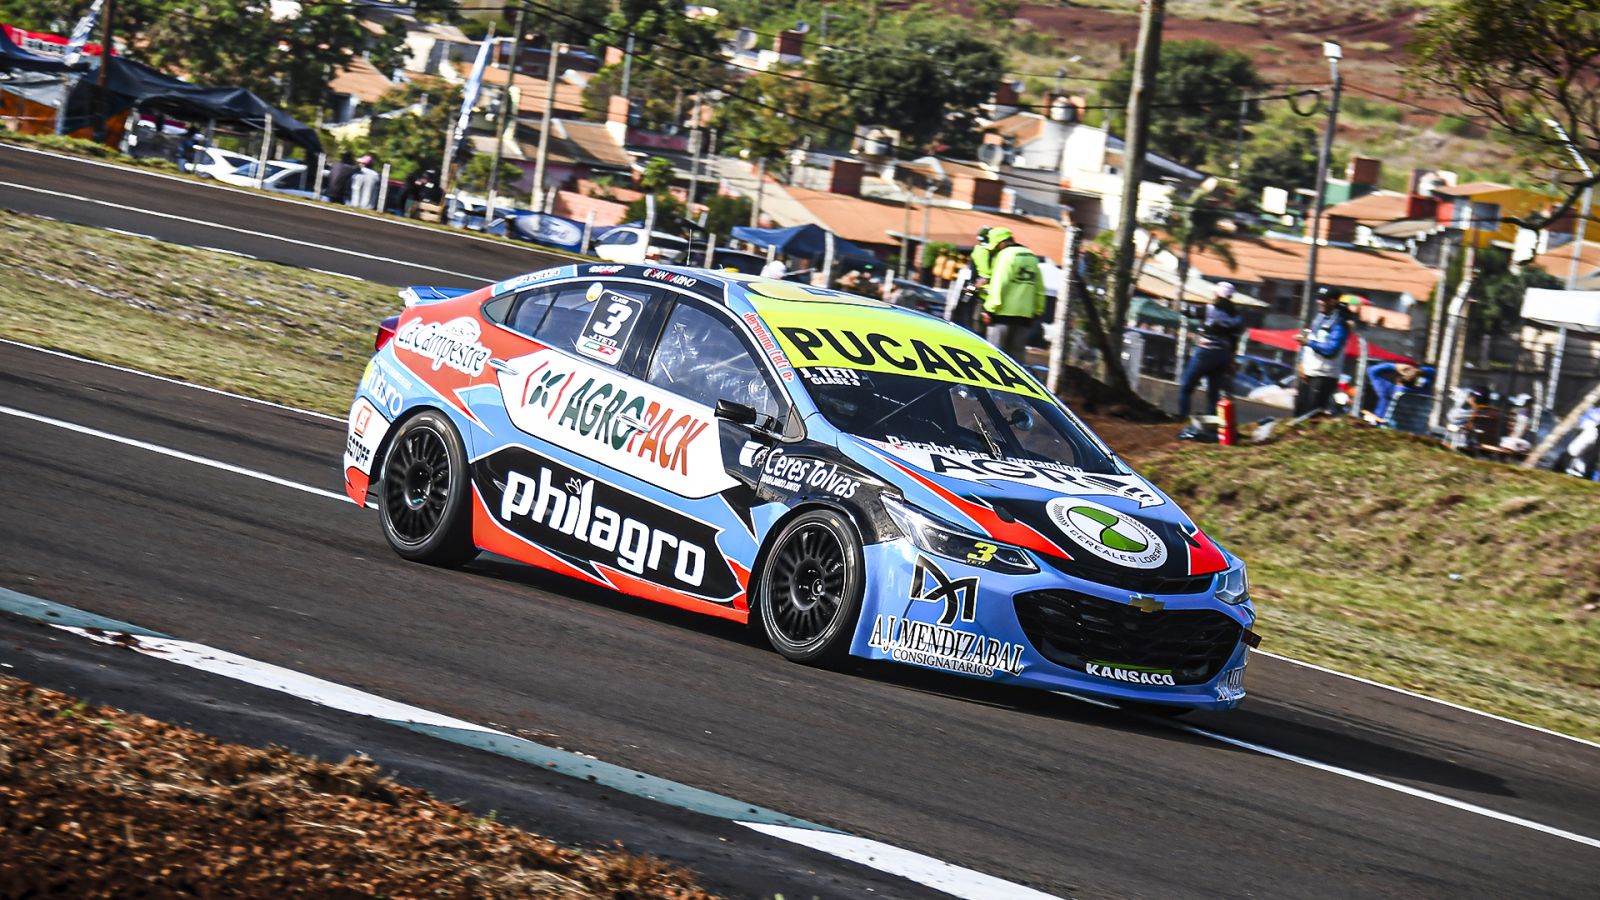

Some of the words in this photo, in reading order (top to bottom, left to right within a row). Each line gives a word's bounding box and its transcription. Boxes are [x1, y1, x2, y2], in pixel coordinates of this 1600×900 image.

[592, 303, 633, 337] 3
[414, 325, 487, 372] Campestre
[778, 327, 1041, 395] PUCARA
[558, 377, 709, 477] AGROPACK
[765, 448, 810, 482] Ceres
[806, 459, 861, 499] Tolvas
[501, 467, 706, 587] philagro
[1069, 530, 1137, 563] CEREALES
[967, 541, 999, 563] 3
[893, 648, 993, 677] CONSIGNATARIOS
[897, 620, 1025, 675] MENDIZABAL
[1085, 662, 1176, 687] KANSACO
